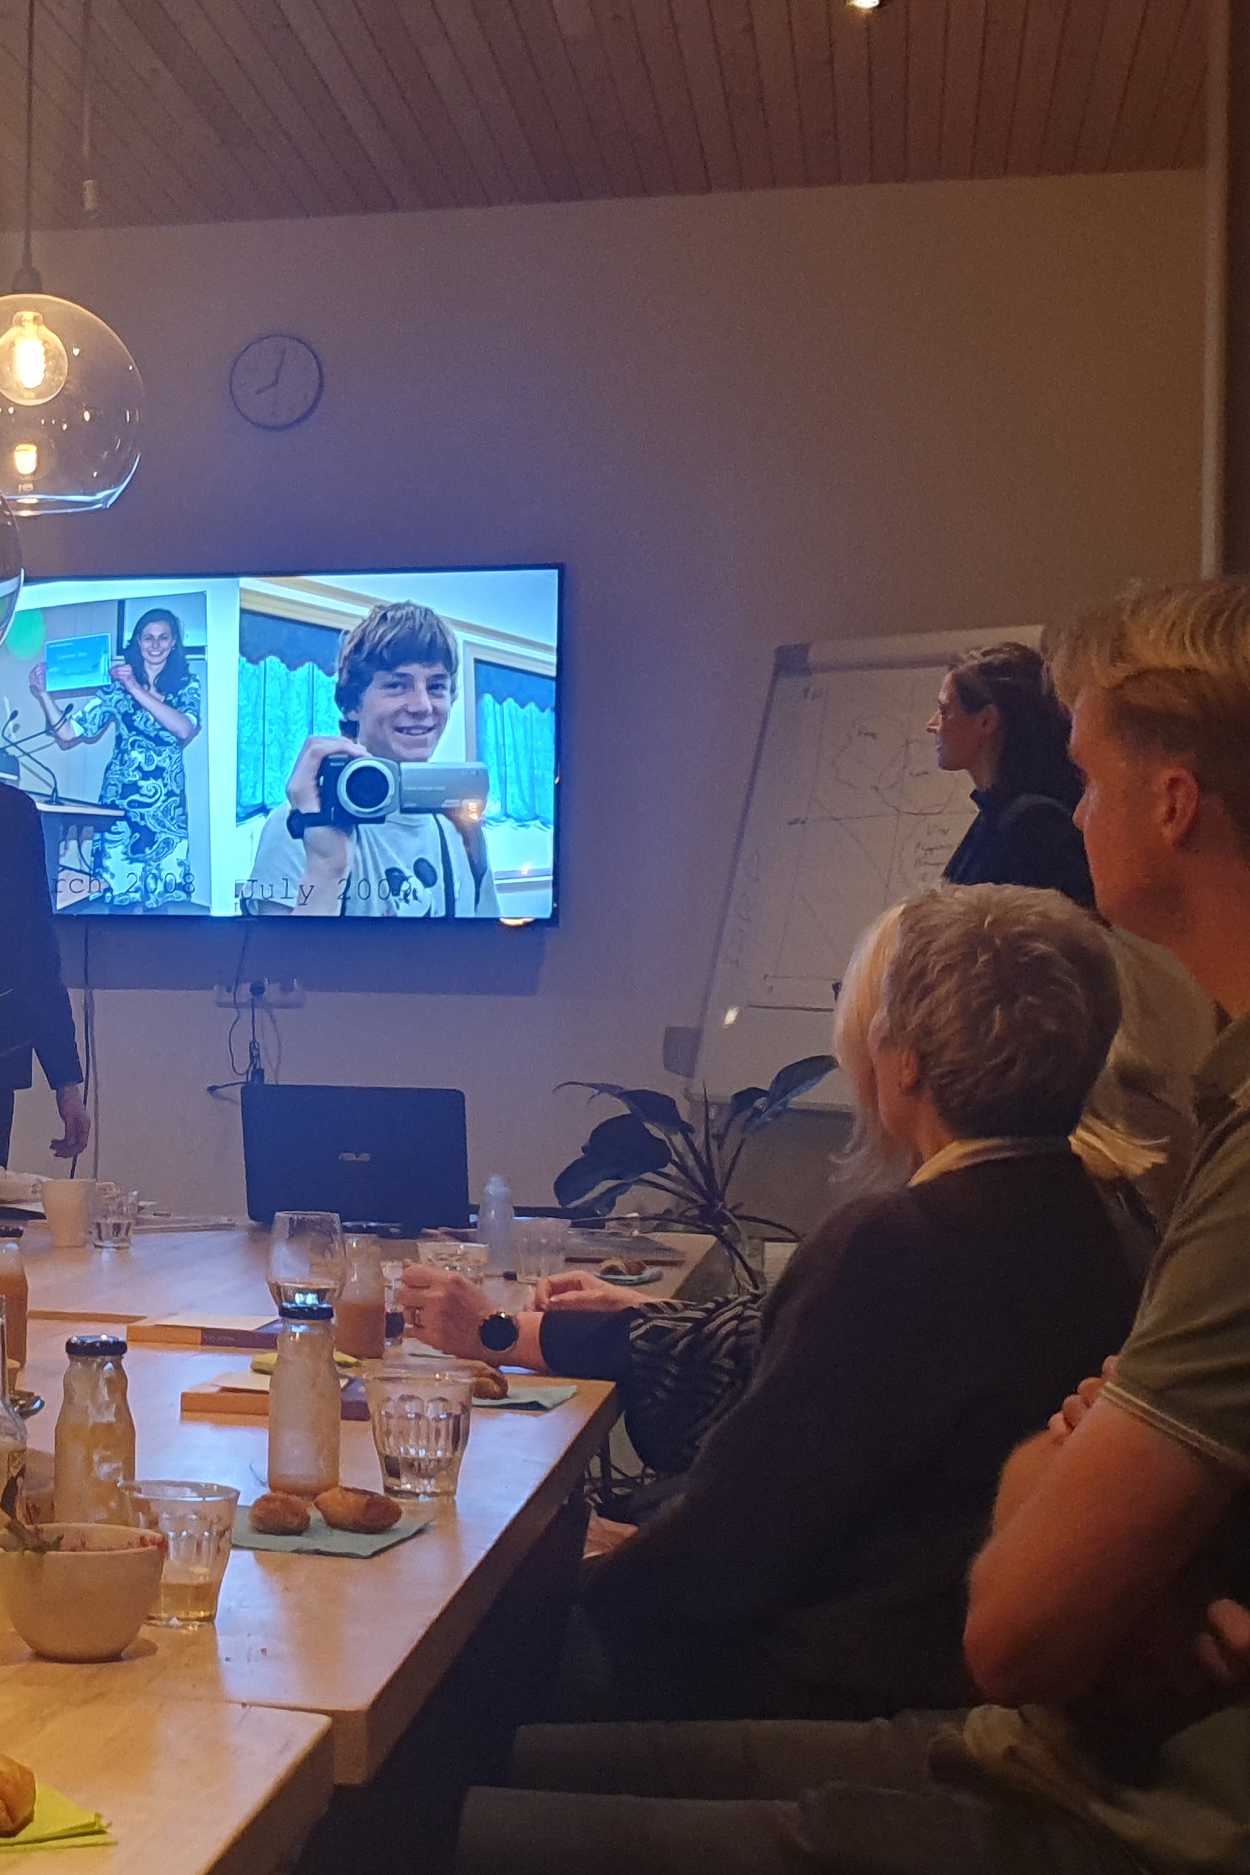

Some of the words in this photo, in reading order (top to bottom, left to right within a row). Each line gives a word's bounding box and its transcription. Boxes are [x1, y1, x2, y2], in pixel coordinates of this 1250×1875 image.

[51, 874, 102, 894] rch
[126, 872, 195, 894] 2008
[241, 877, 315, 906] July
